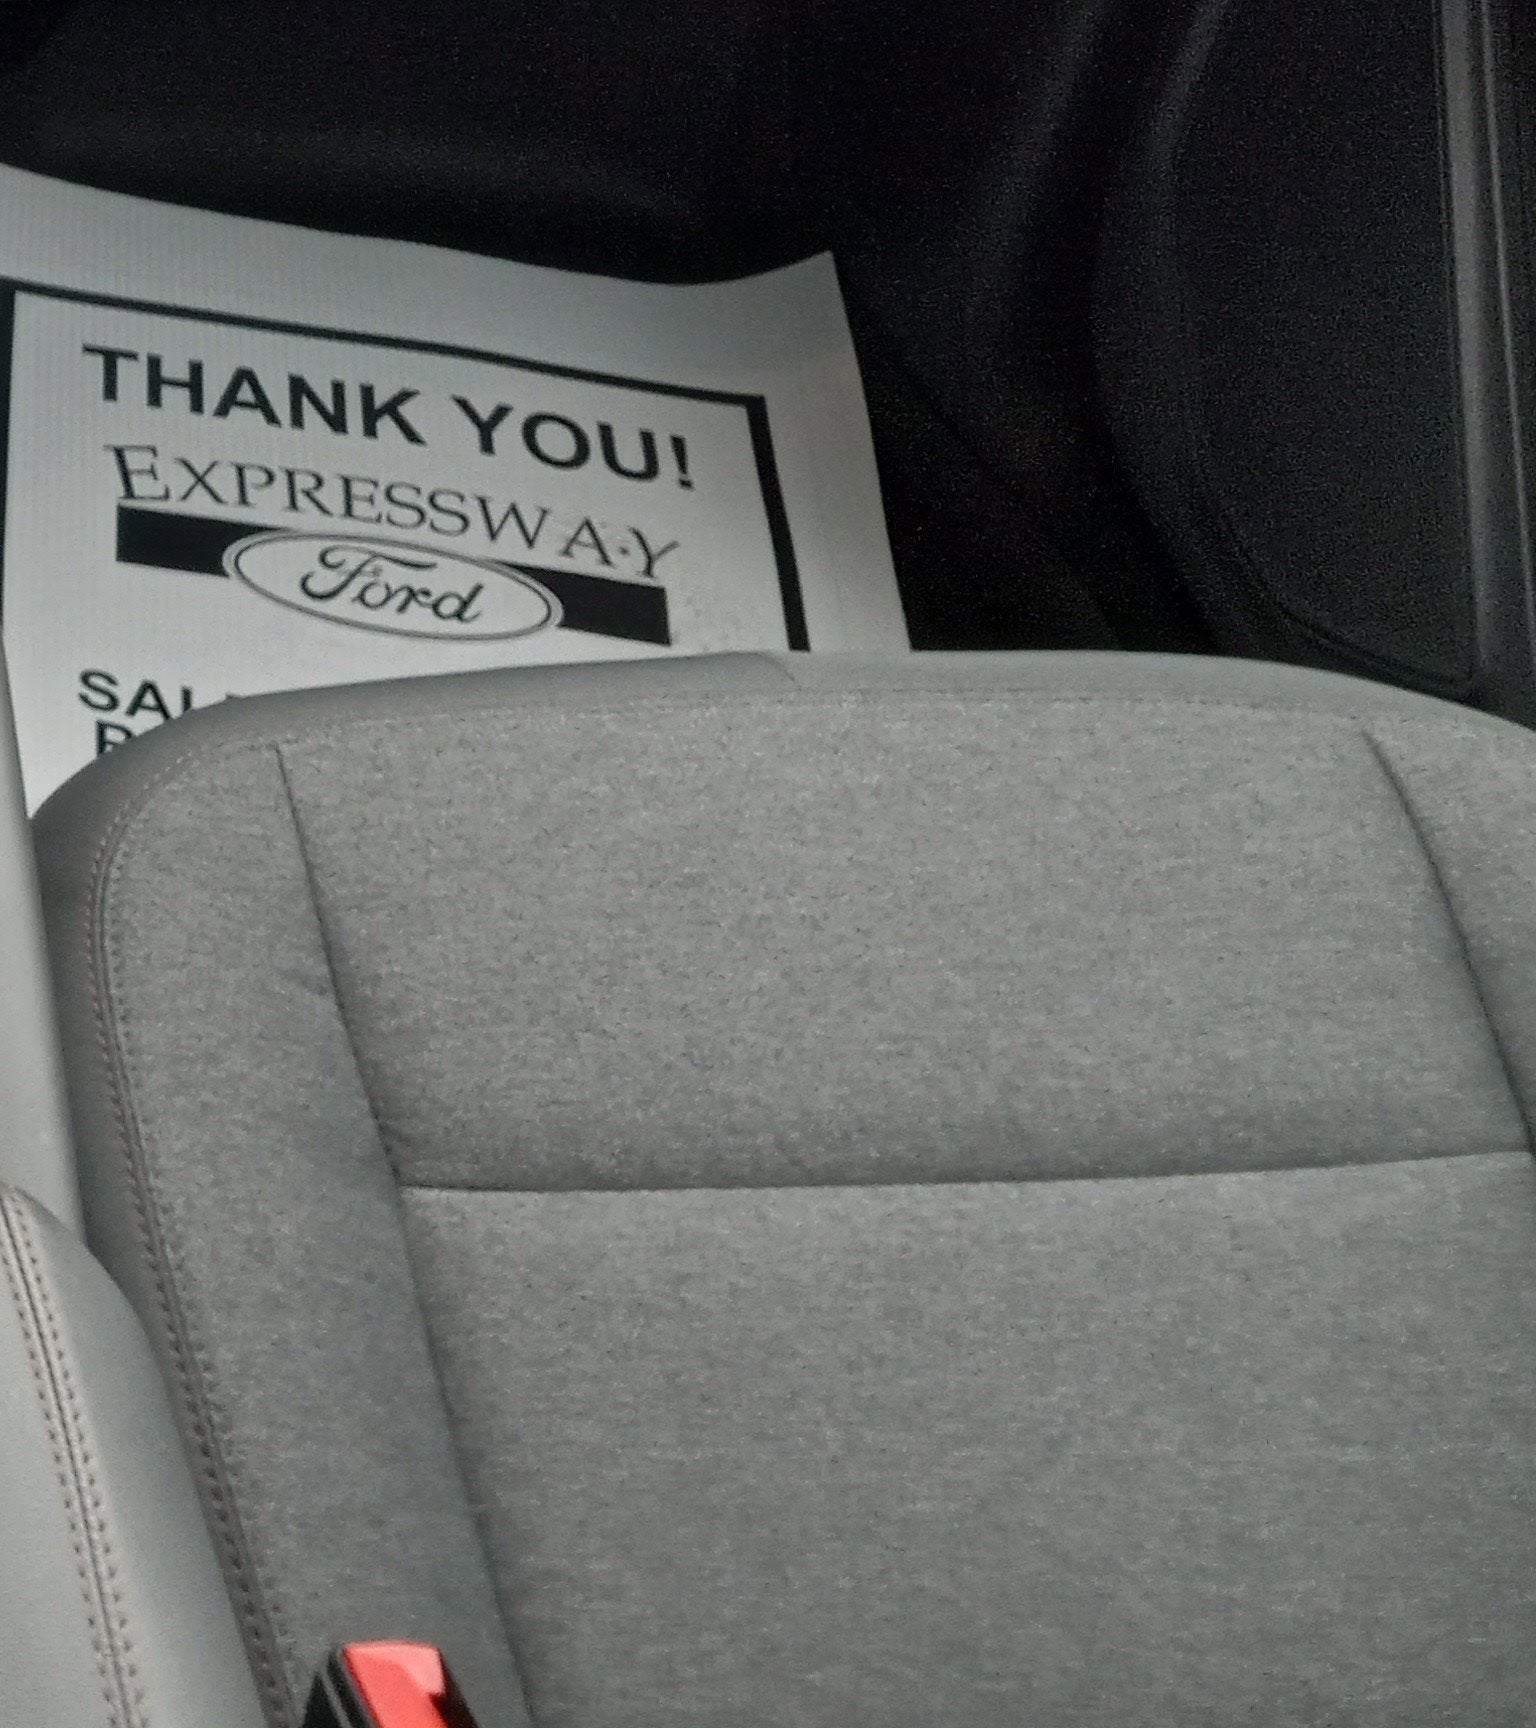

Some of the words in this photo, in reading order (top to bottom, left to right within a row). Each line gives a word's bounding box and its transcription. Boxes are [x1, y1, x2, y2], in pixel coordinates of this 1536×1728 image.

[82, 342, 428, 448] THANK
[451, 394, 697, 489] YOU!
[300, 544, 486, 626] Ford
